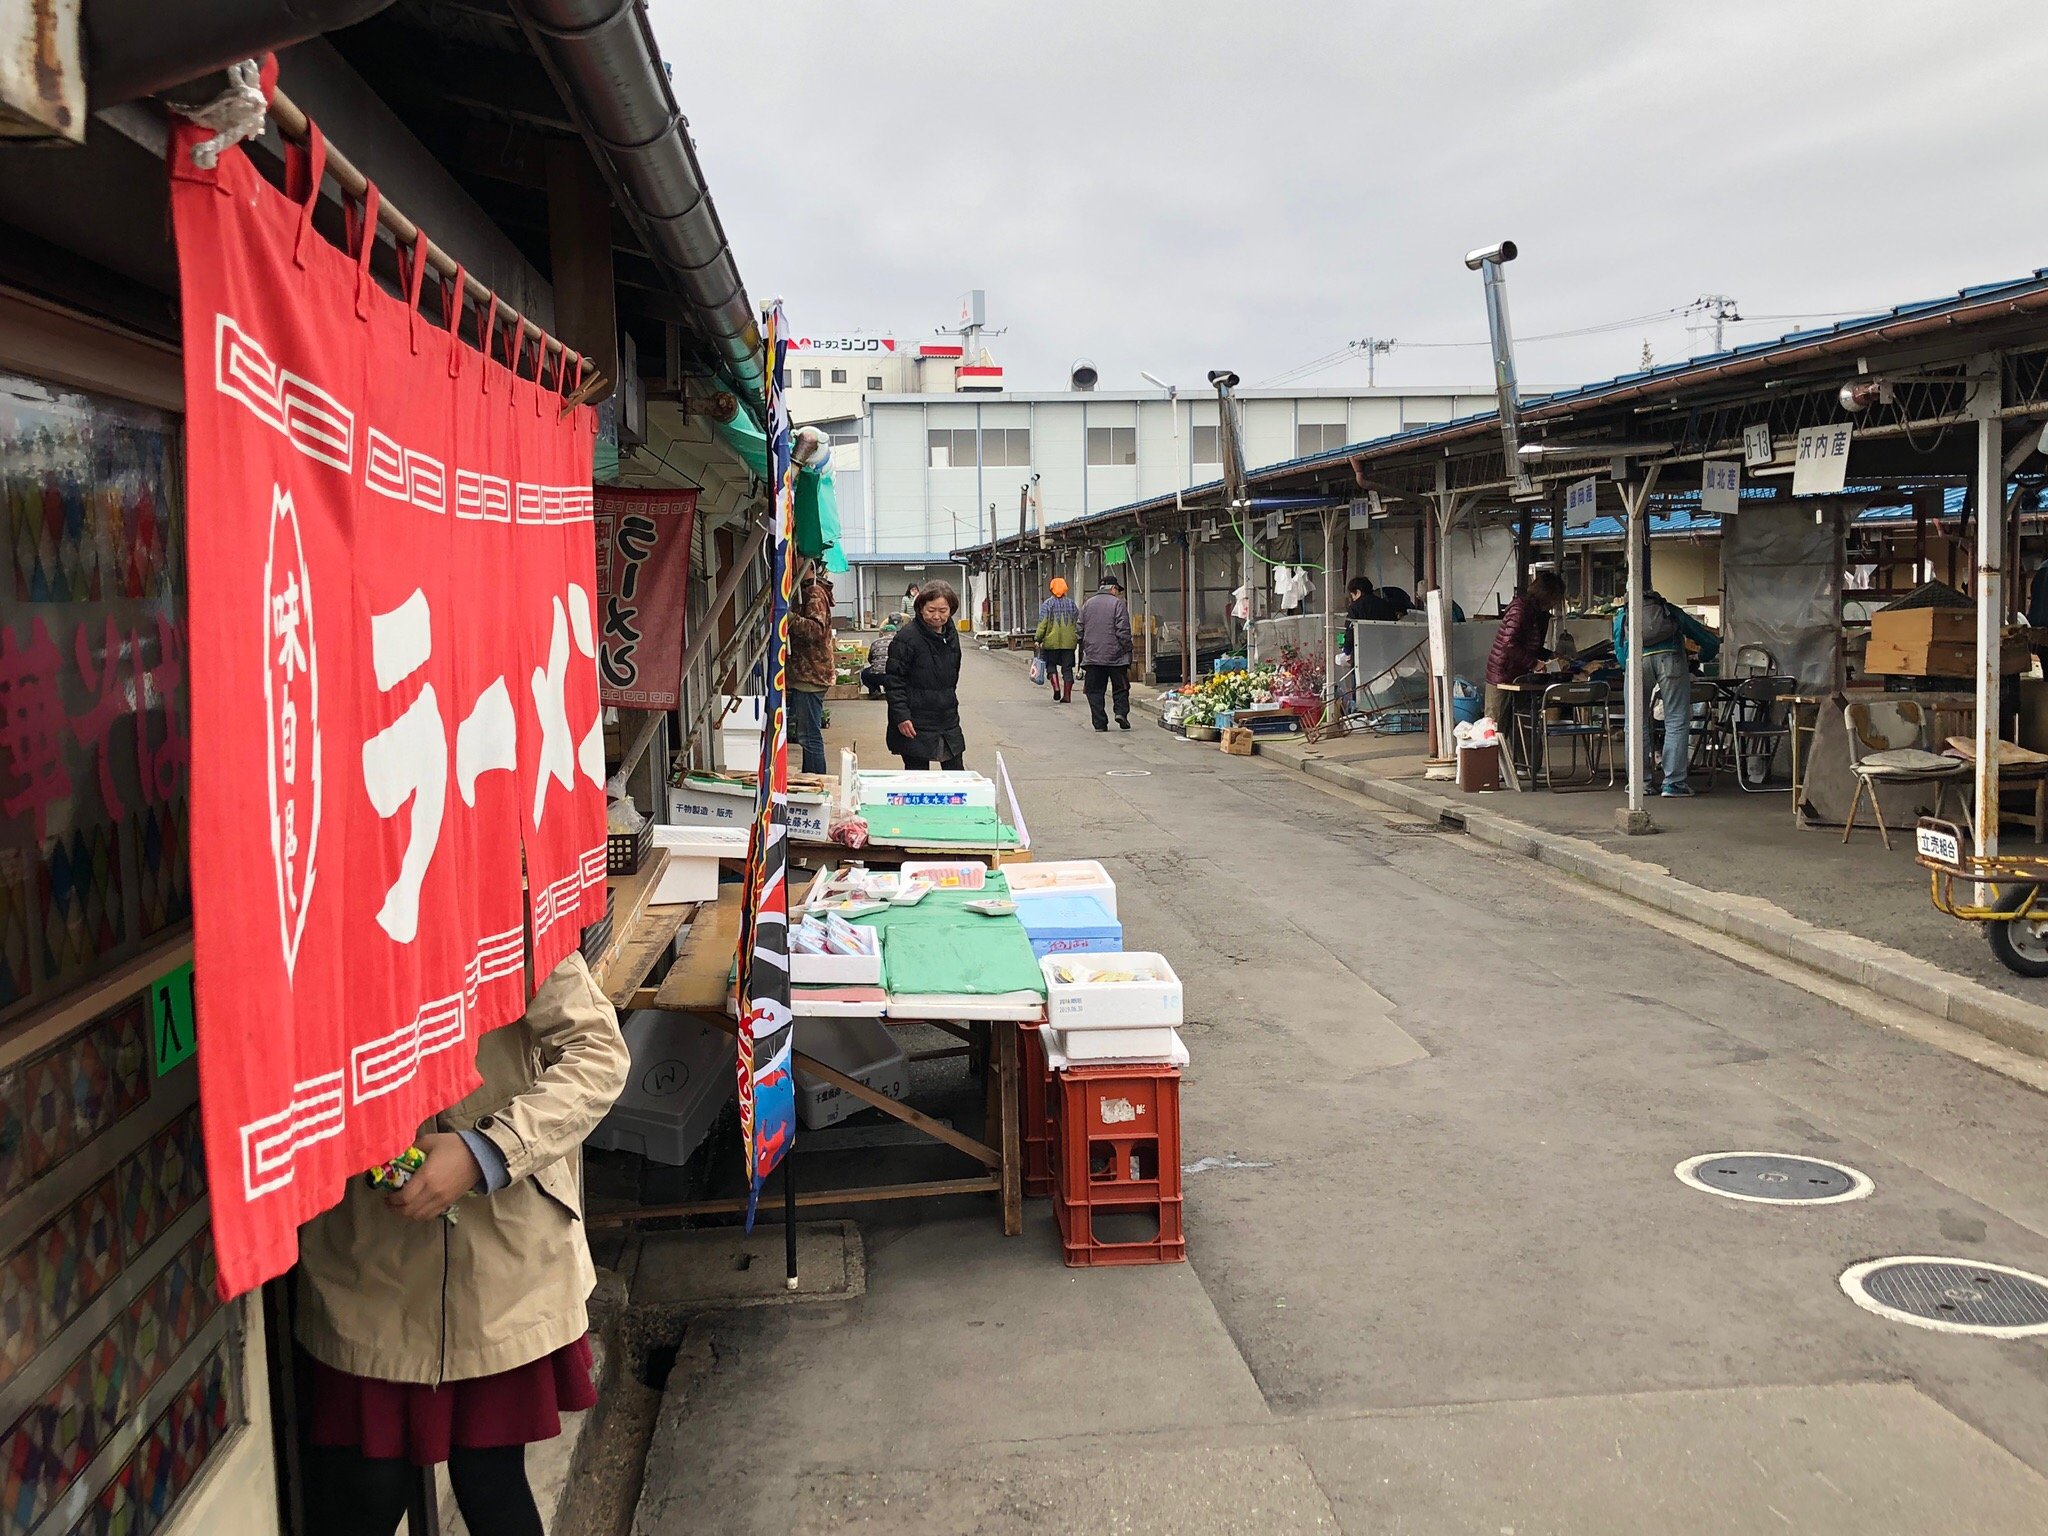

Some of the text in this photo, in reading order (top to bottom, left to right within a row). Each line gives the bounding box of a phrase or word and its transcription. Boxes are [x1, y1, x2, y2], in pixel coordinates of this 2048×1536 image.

[1745, 430, 1769, 460] B-13
[1799, 430, 1847, 460] 沢内産
[1921, 833, 1955, 859] 立売組合
